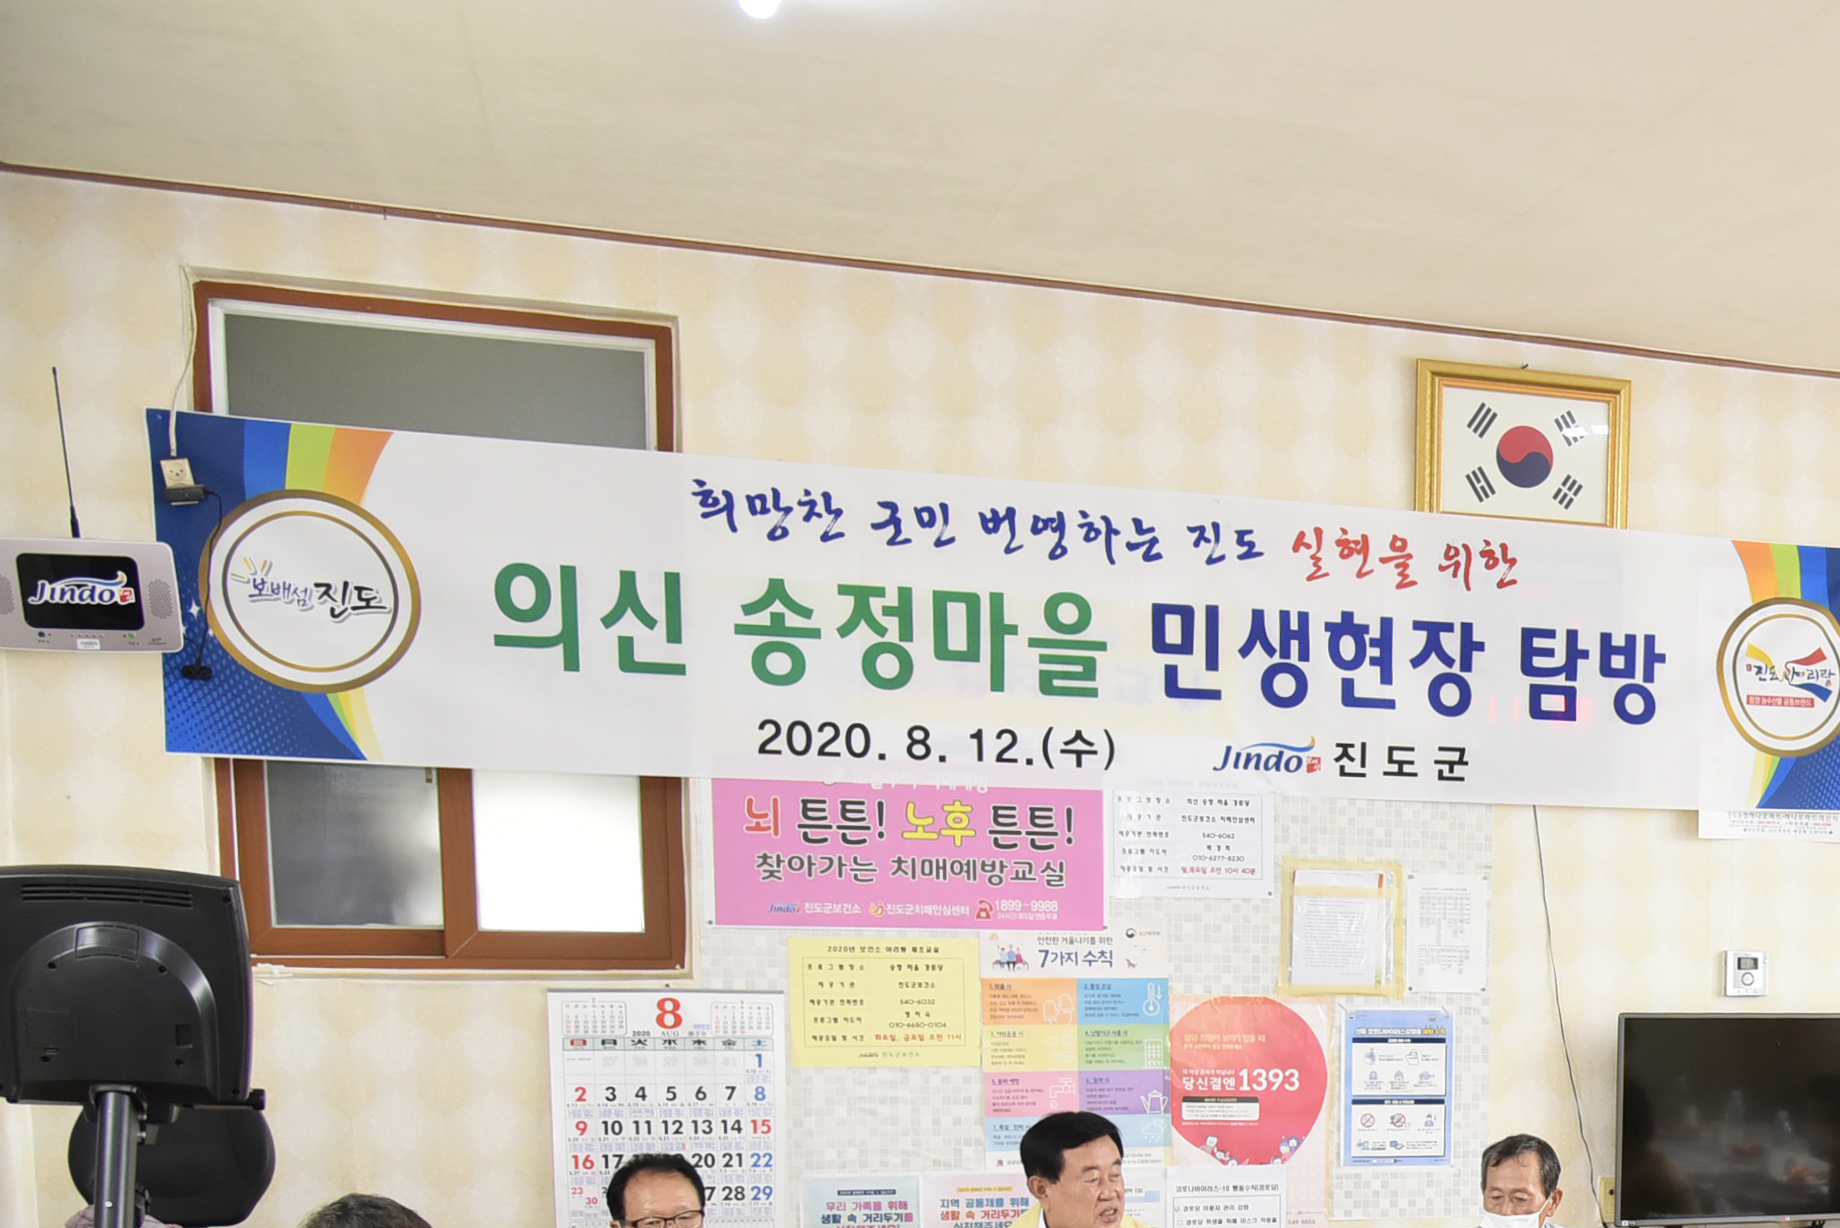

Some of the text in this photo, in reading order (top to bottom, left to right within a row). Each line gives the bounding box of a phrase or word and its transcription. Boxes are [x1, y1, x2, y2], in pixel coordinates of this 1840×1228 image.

[692, 478, 1519, 592] 희망찬 군민 번영하는 진도 실현을 위한
[28, 579, 117, 606] Jindo
[247, 576, 394, 621] 보배섬 진도
[492, 561, 1667, 726] 의신 송정마을 민생현장 탐방
[756, 718, 1118, 772] 2020. 8. 12.(수)
[1213, 740, 1304, 776] Jindo
[1332, 741, 1471, 783] 진도군
[744, 796, 1074, 851] 뇌 튼튼! 노후 튼튼!
[755, 852, 1066, 888] 찾아가는 치매예방교실
[804, 902, 862, 914] 진도군보건소
[886, 903, 970, 917] 진도군치매안심센터
[1038, 949, 1114, 968] 7가지 수칙
[655, 997, 683, 1030] 8
[755, 1053, 763, 1068] 1
[1238, 1068, 1301, 1092] 1393
[574, 1086, 767, 1102] 2 3 4 5 6 7 8
[575, 1118, 772, 1136] 9 10 11 12 13 14 15
[571, 1152, 773, 1170] 16 17 20 21 22
[571, 1185, 773, 1201] 23 28 29
[585, 1197, 598, 1205] 30
[825, 1200, 909, 1212] 우리 가족을 위해
[940, 1198, 960, 1209] 지역
[1009, 1197, 1030, 1207] 위해
[821, 1212, 914, 1225] 생활 속 거리두기를
[940, 1210, 960, 1221] 생활
